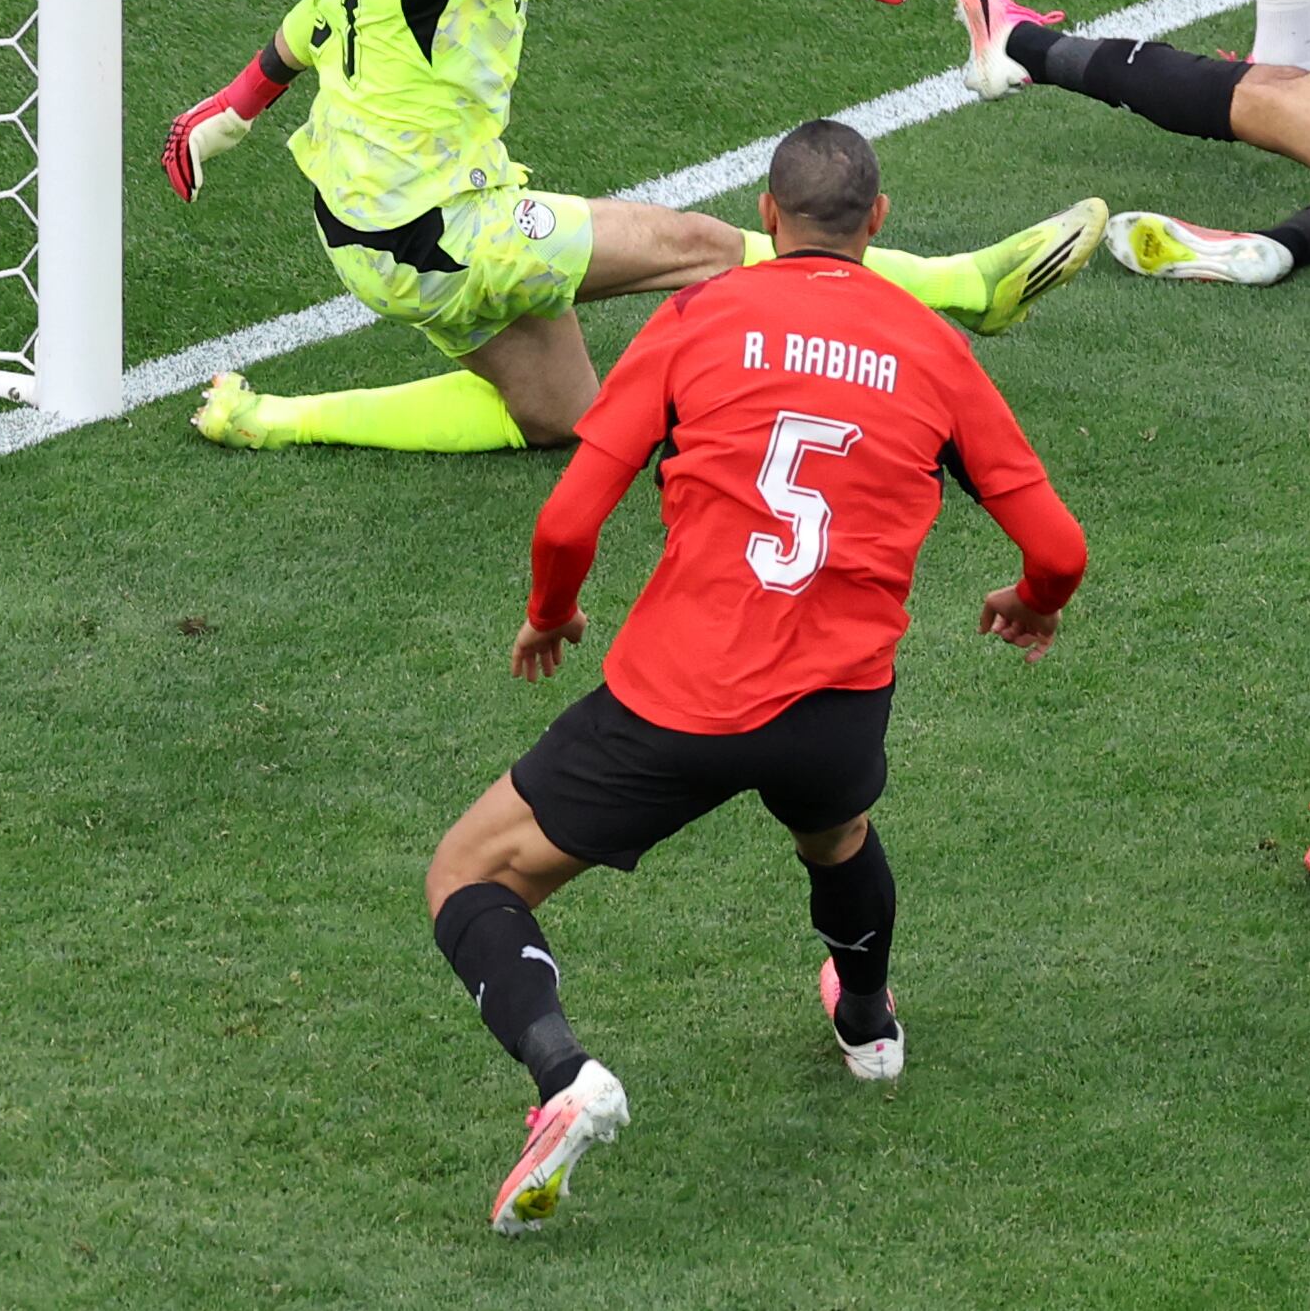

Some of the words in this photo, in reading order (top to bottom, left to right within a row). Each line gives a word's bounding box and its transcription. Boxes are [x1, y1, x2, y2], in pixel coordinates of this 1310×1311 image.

[743, 331, 770, 370] R.
[784, 333, 897, 394] RABIAA
[745, 411, 862, 595] 5
